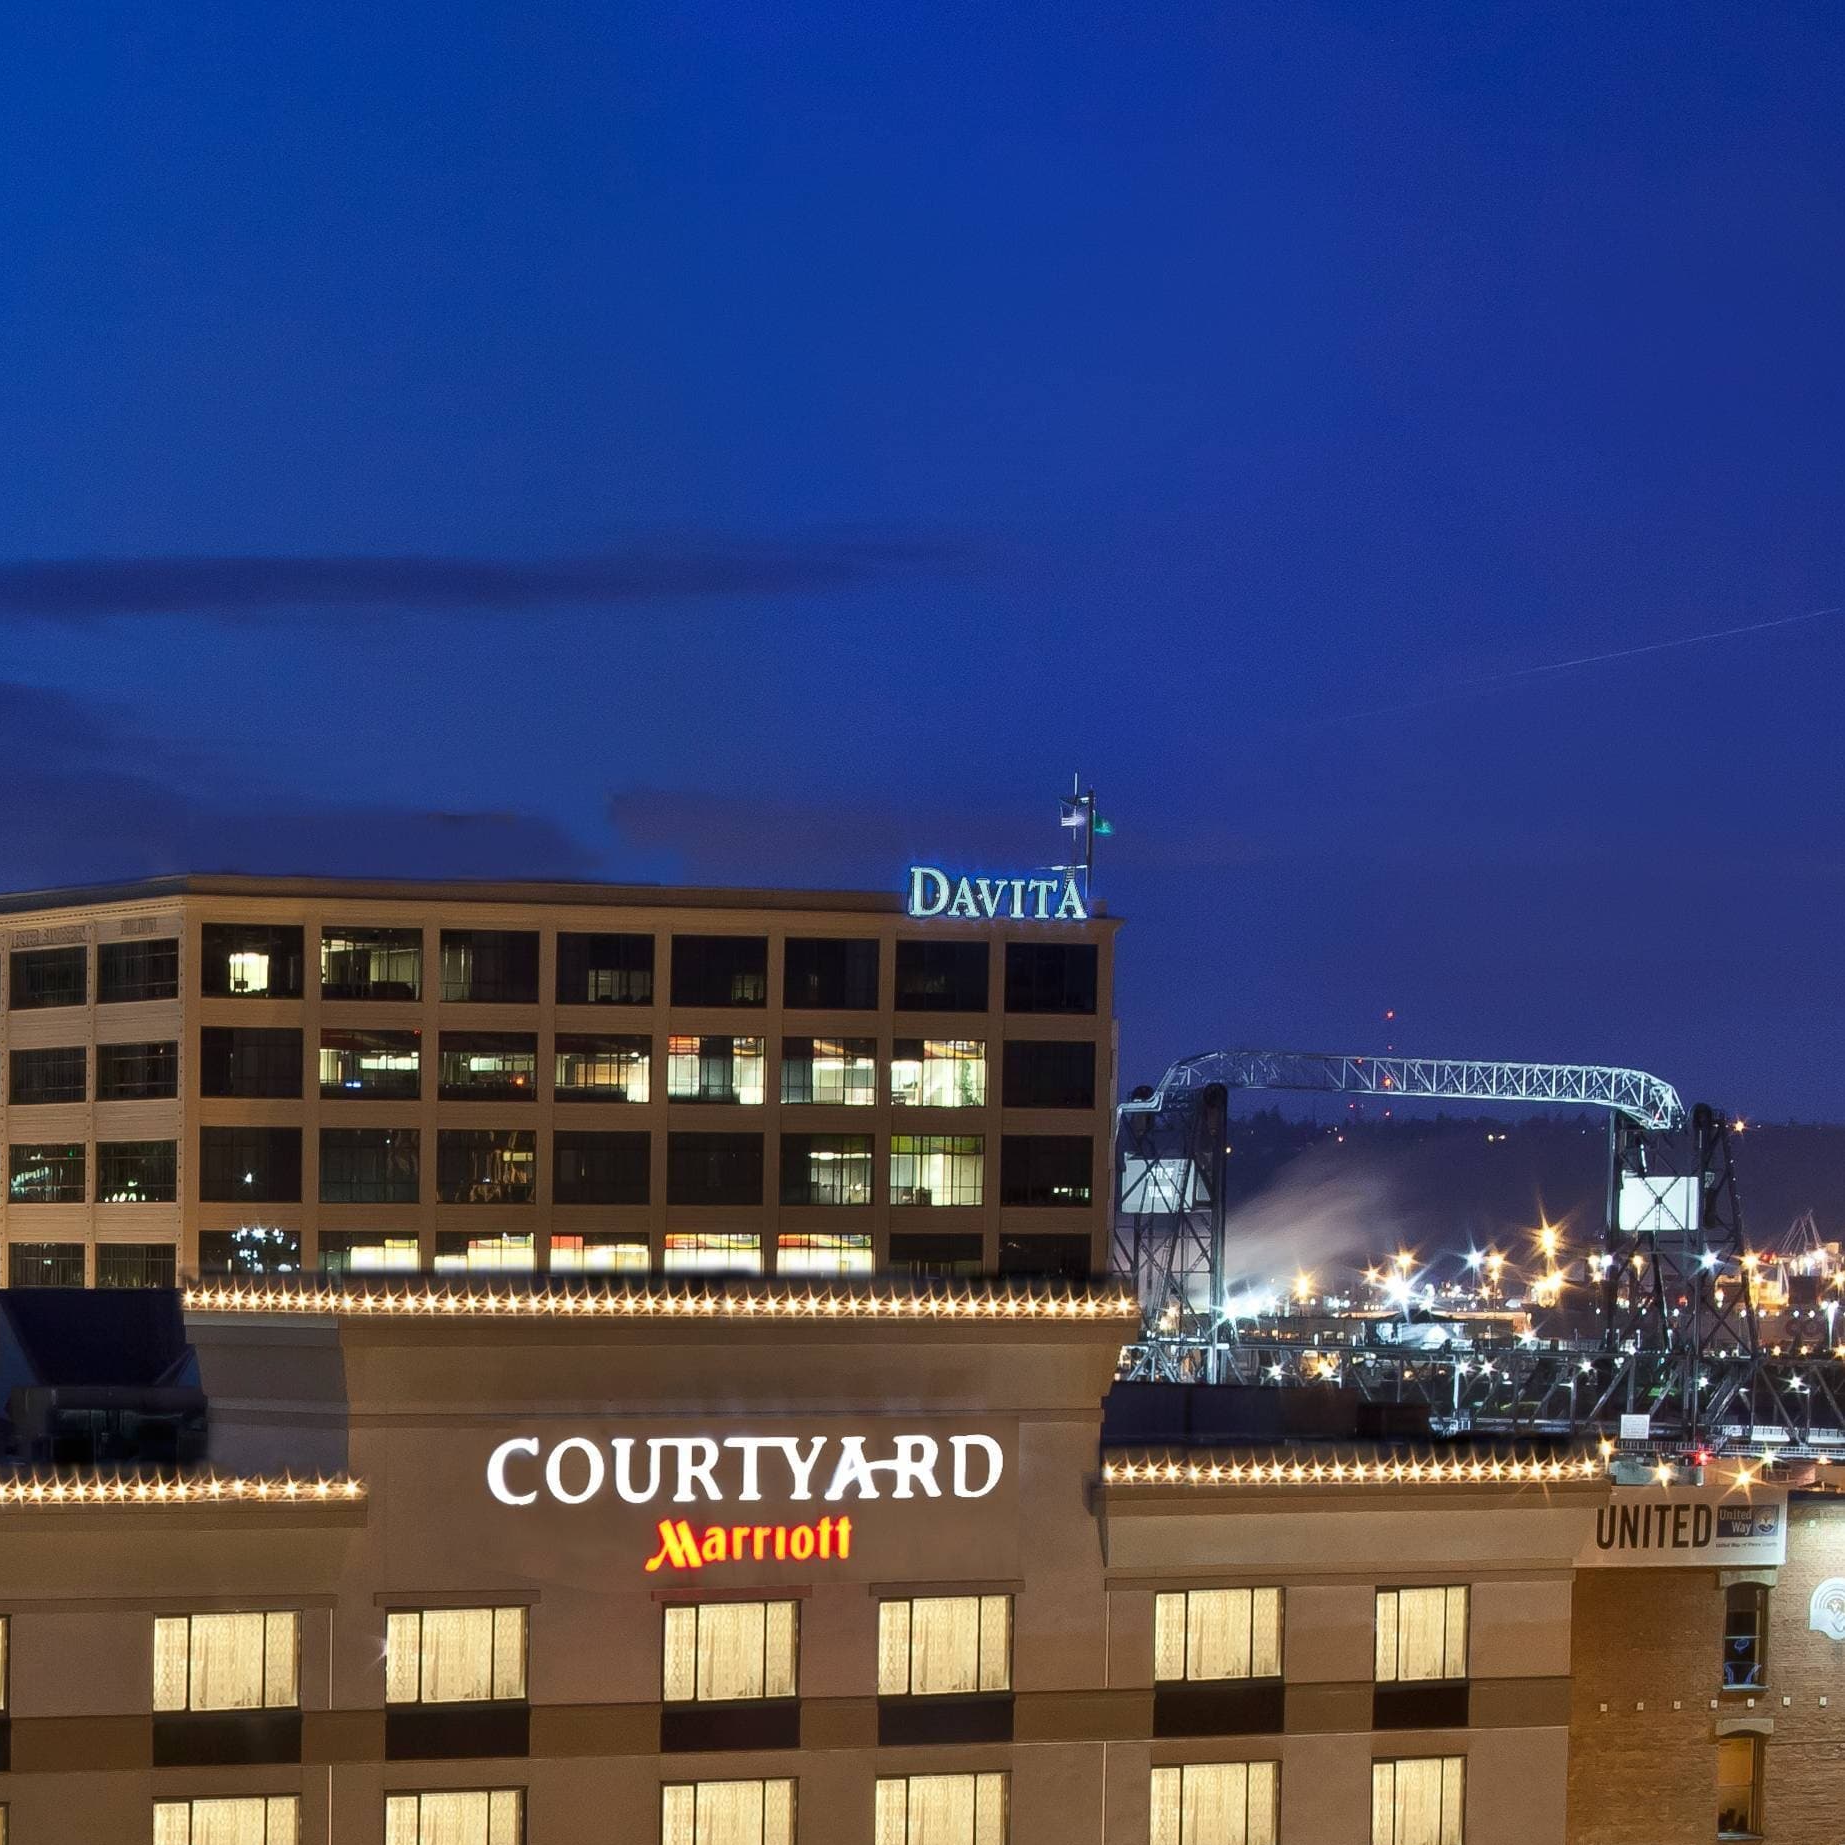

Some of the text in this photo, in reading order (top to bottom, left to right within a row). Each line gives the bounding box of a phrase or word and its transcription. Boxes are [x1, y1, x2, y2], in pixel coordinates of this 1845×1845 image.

[909, 866, 1087, 919] DAVITA
[487, 1434, 1004, 1505] COURTYARD
[1596, 1504, 1712, 1549] UNITED
[1719, 1508, 1752, 1520] United
[1731, 1521, 1752, 1536] Way
[644, 1516, 852, 1572] Marriott
